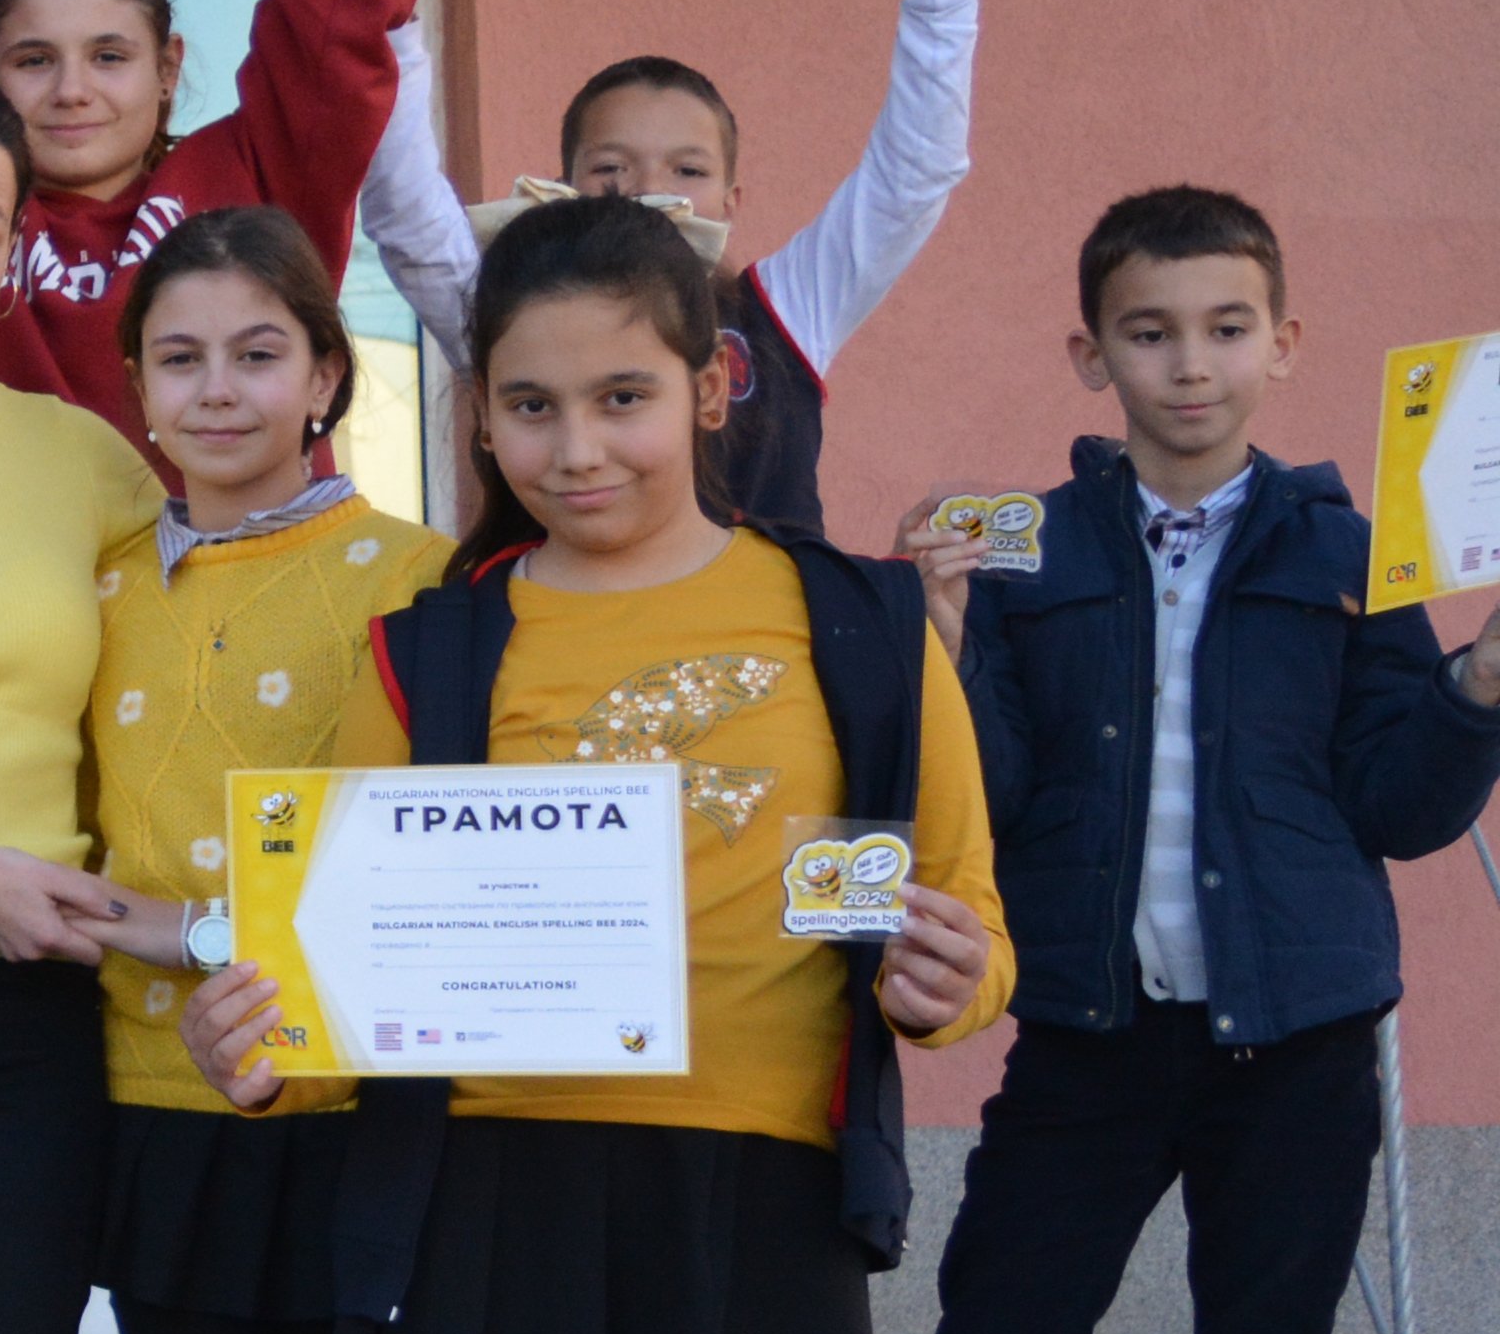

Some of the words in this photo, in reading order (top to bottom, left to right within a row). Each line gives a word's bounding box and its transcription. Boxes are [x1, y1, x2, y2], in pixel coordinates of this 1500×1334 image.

[394, 803, 627, 832] ГРАМОТА
[262, 841, 294, 853] BEE
[842, 891, 894, 906] 2024
[442, 981, 576, 991] CONGRATULATIONS!
